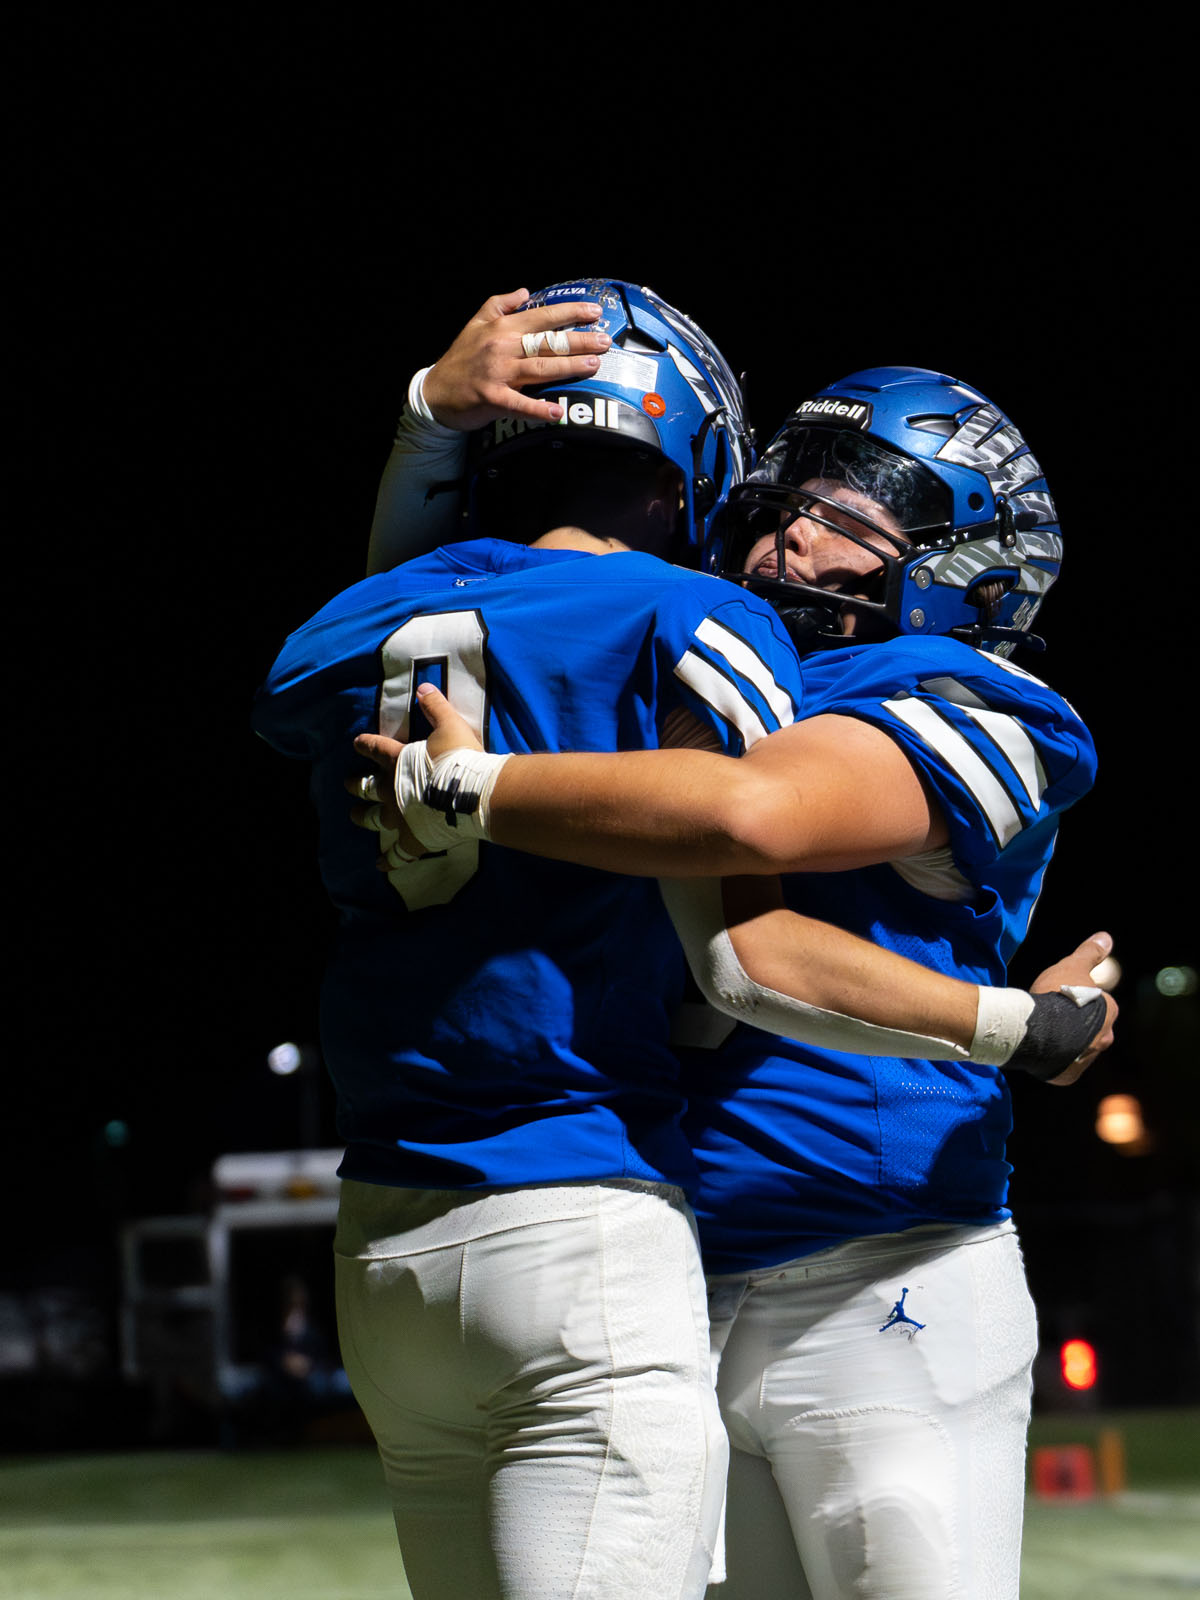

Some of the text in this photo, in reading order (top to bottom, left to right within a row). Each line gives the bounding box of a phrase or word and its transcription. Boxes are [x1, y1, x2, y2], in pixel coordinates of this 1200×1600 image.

[547, 287, 586, 297] SYLVA
[795, 400, 866, 419] Riddell
[495, 396, 619, 447] Rdell
